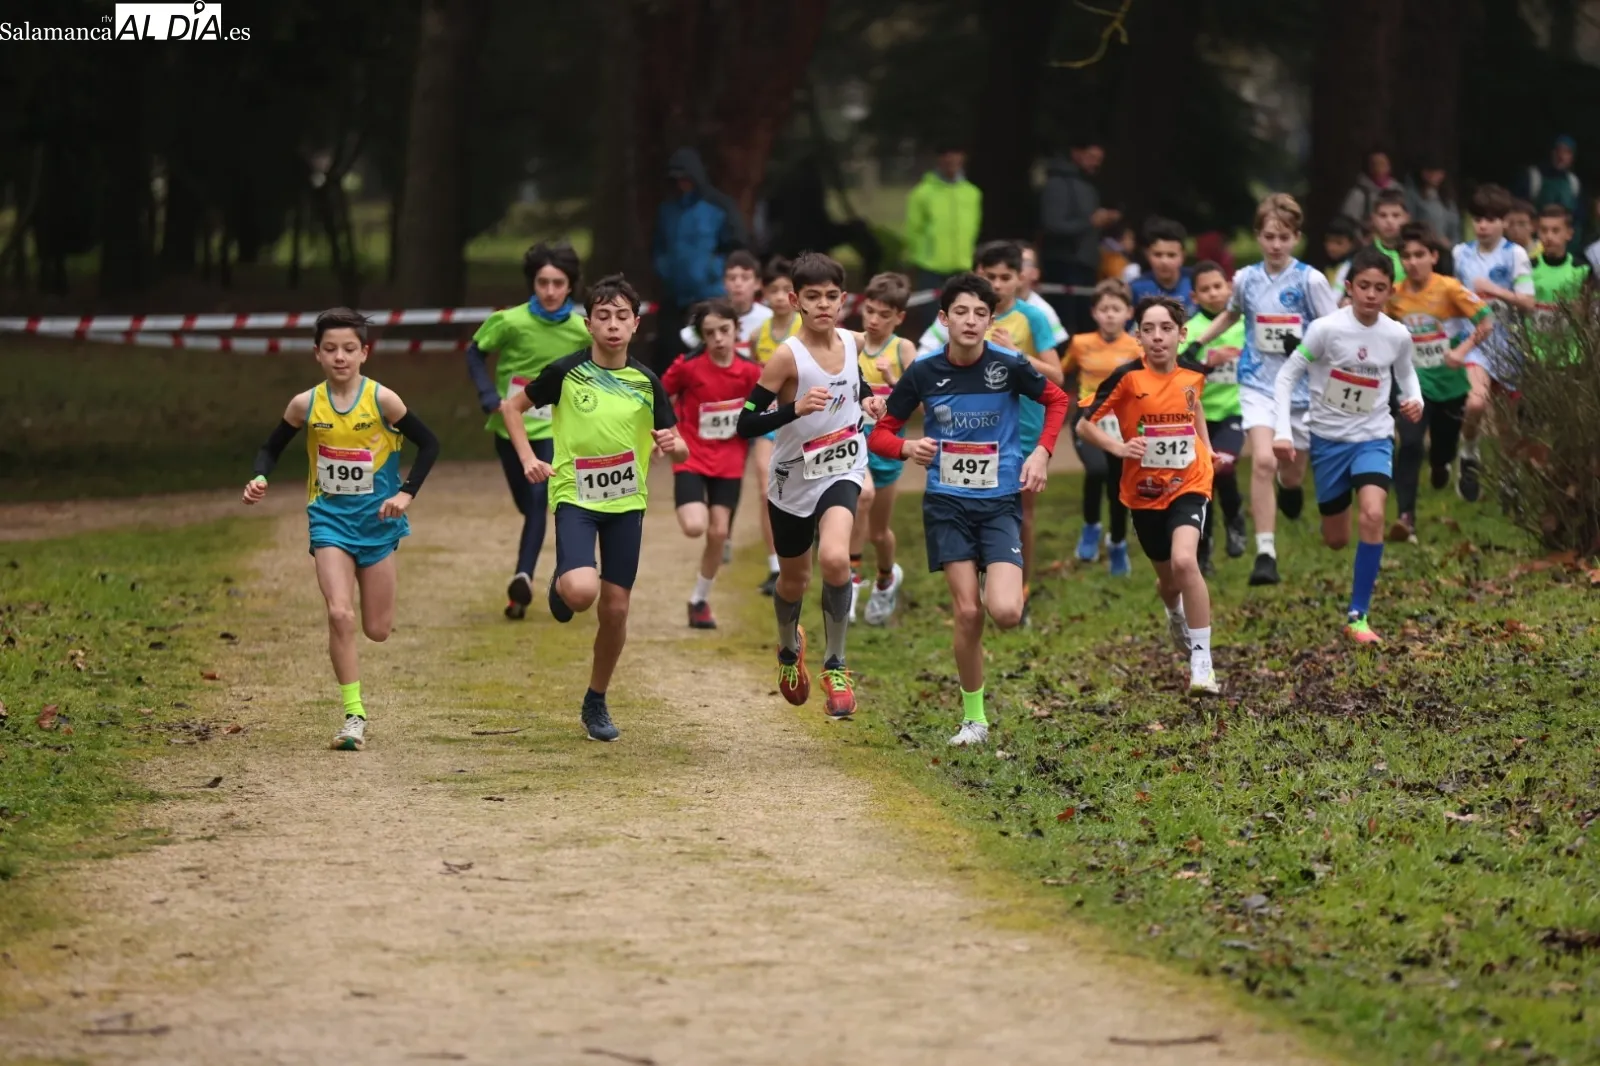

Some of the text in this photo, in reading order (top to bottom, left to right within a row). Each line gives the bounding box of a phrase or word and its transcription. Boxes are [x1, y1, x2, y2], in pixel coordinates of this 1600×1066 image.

[1342, 386, 1363, 402] 11
[953, 416, 1000, 430] MORO
[812, 440, 859, 465] 1250
[1155, 440, 1188, 456] 312
[326, 463, 364, 481] 190
[952, 458, 990, 475] 497
[583, 466, 635, 489] 1004
